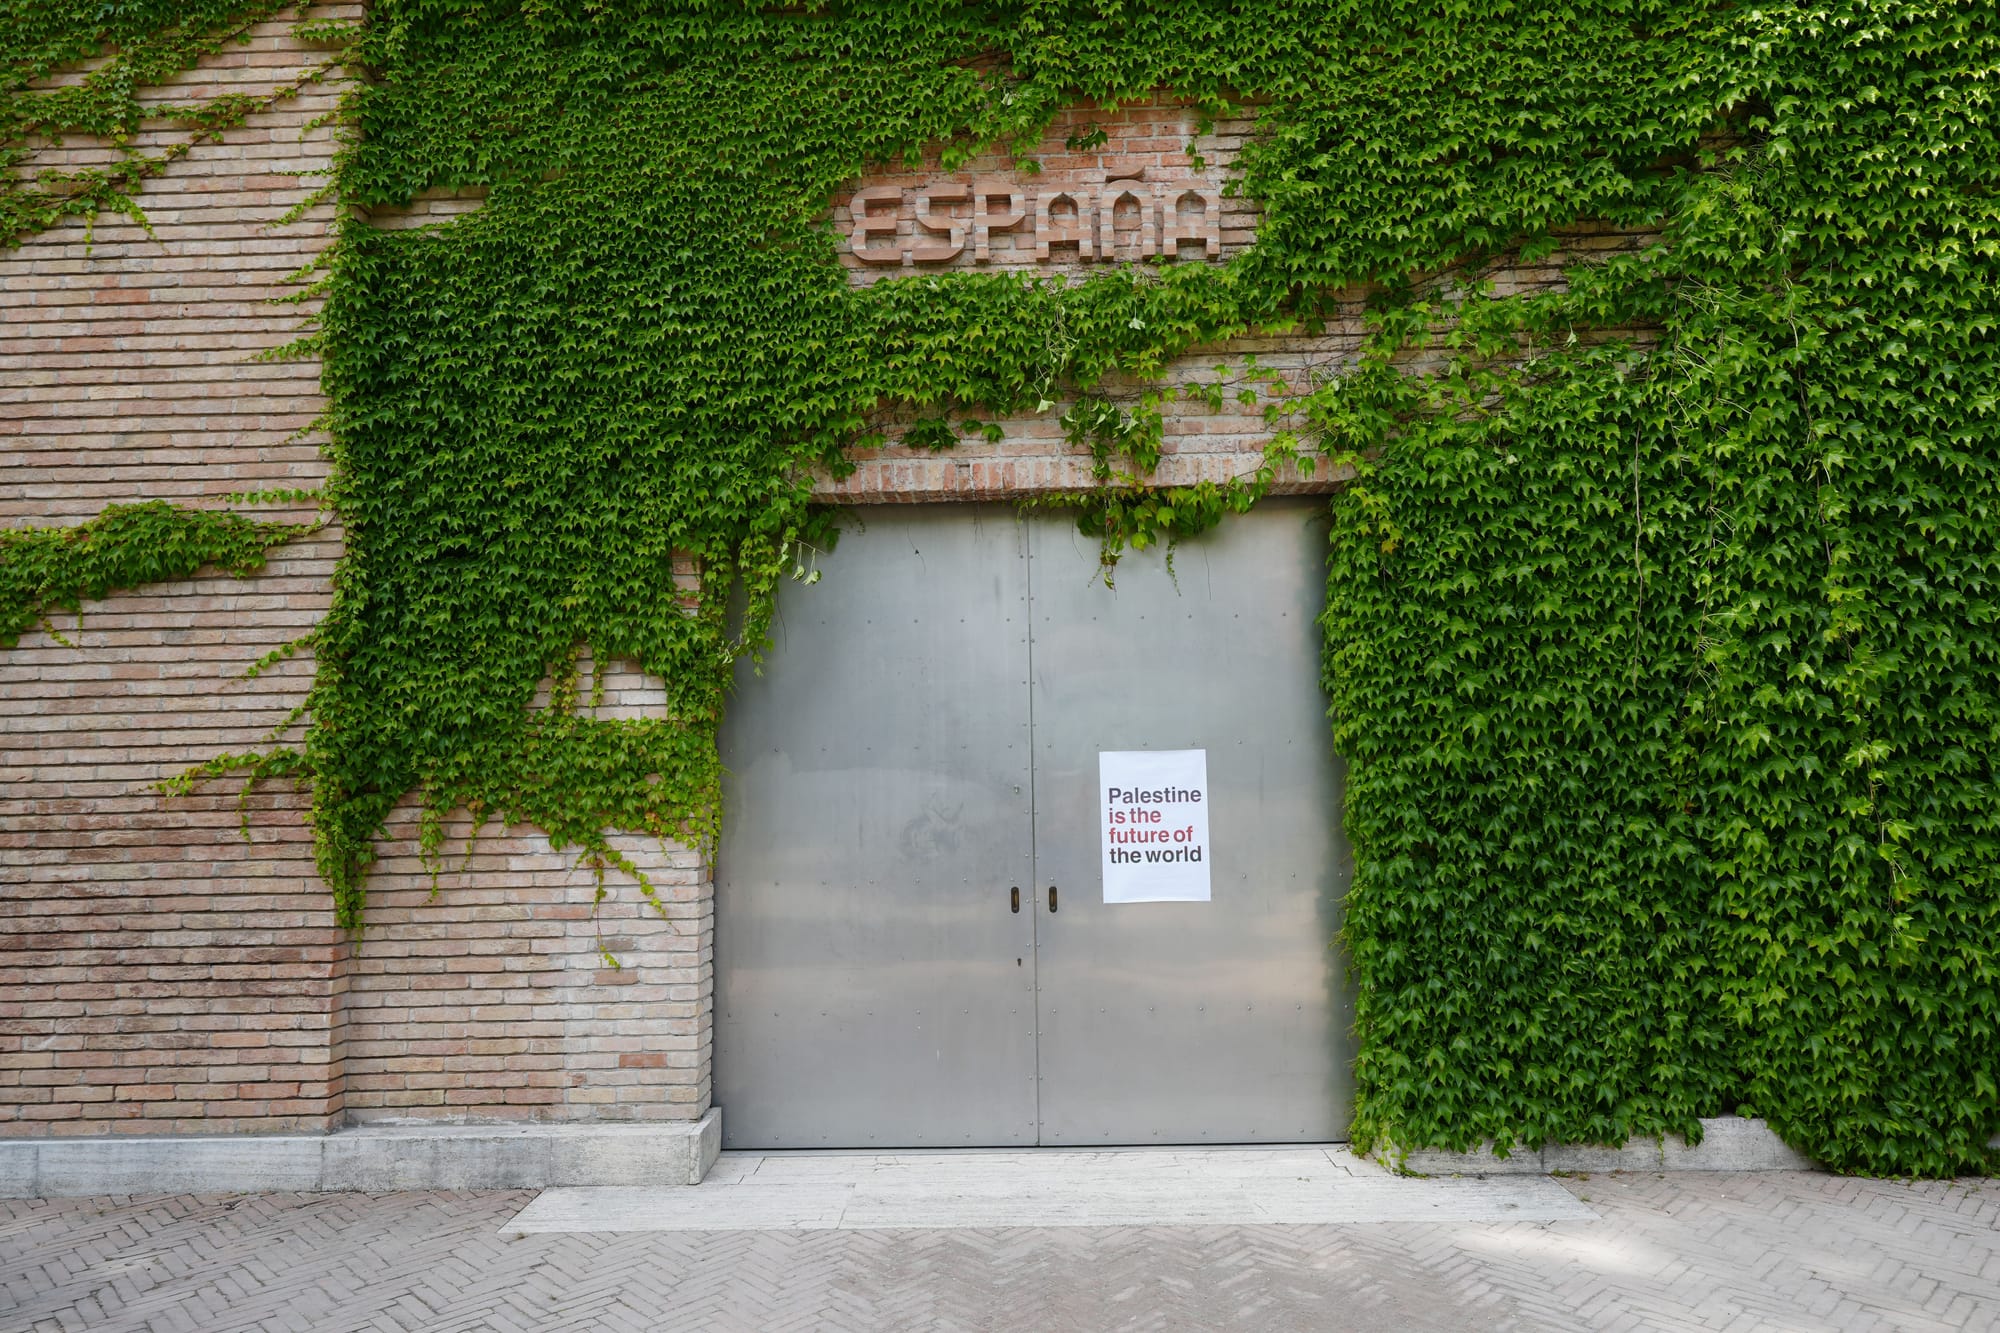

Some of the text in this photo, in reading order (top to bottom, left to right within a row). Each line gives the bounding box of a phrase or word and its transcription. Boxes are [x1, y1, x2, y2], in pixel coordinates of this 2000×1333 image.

[851, 164, 1220, 265] ESPAÑA
[1108, 786, 1201, 804] Palestine
[1109, 807, 1162, 824] is the
[1109, 825, 1193, 843] future of
[1109, 845, 1202, 864] the world
